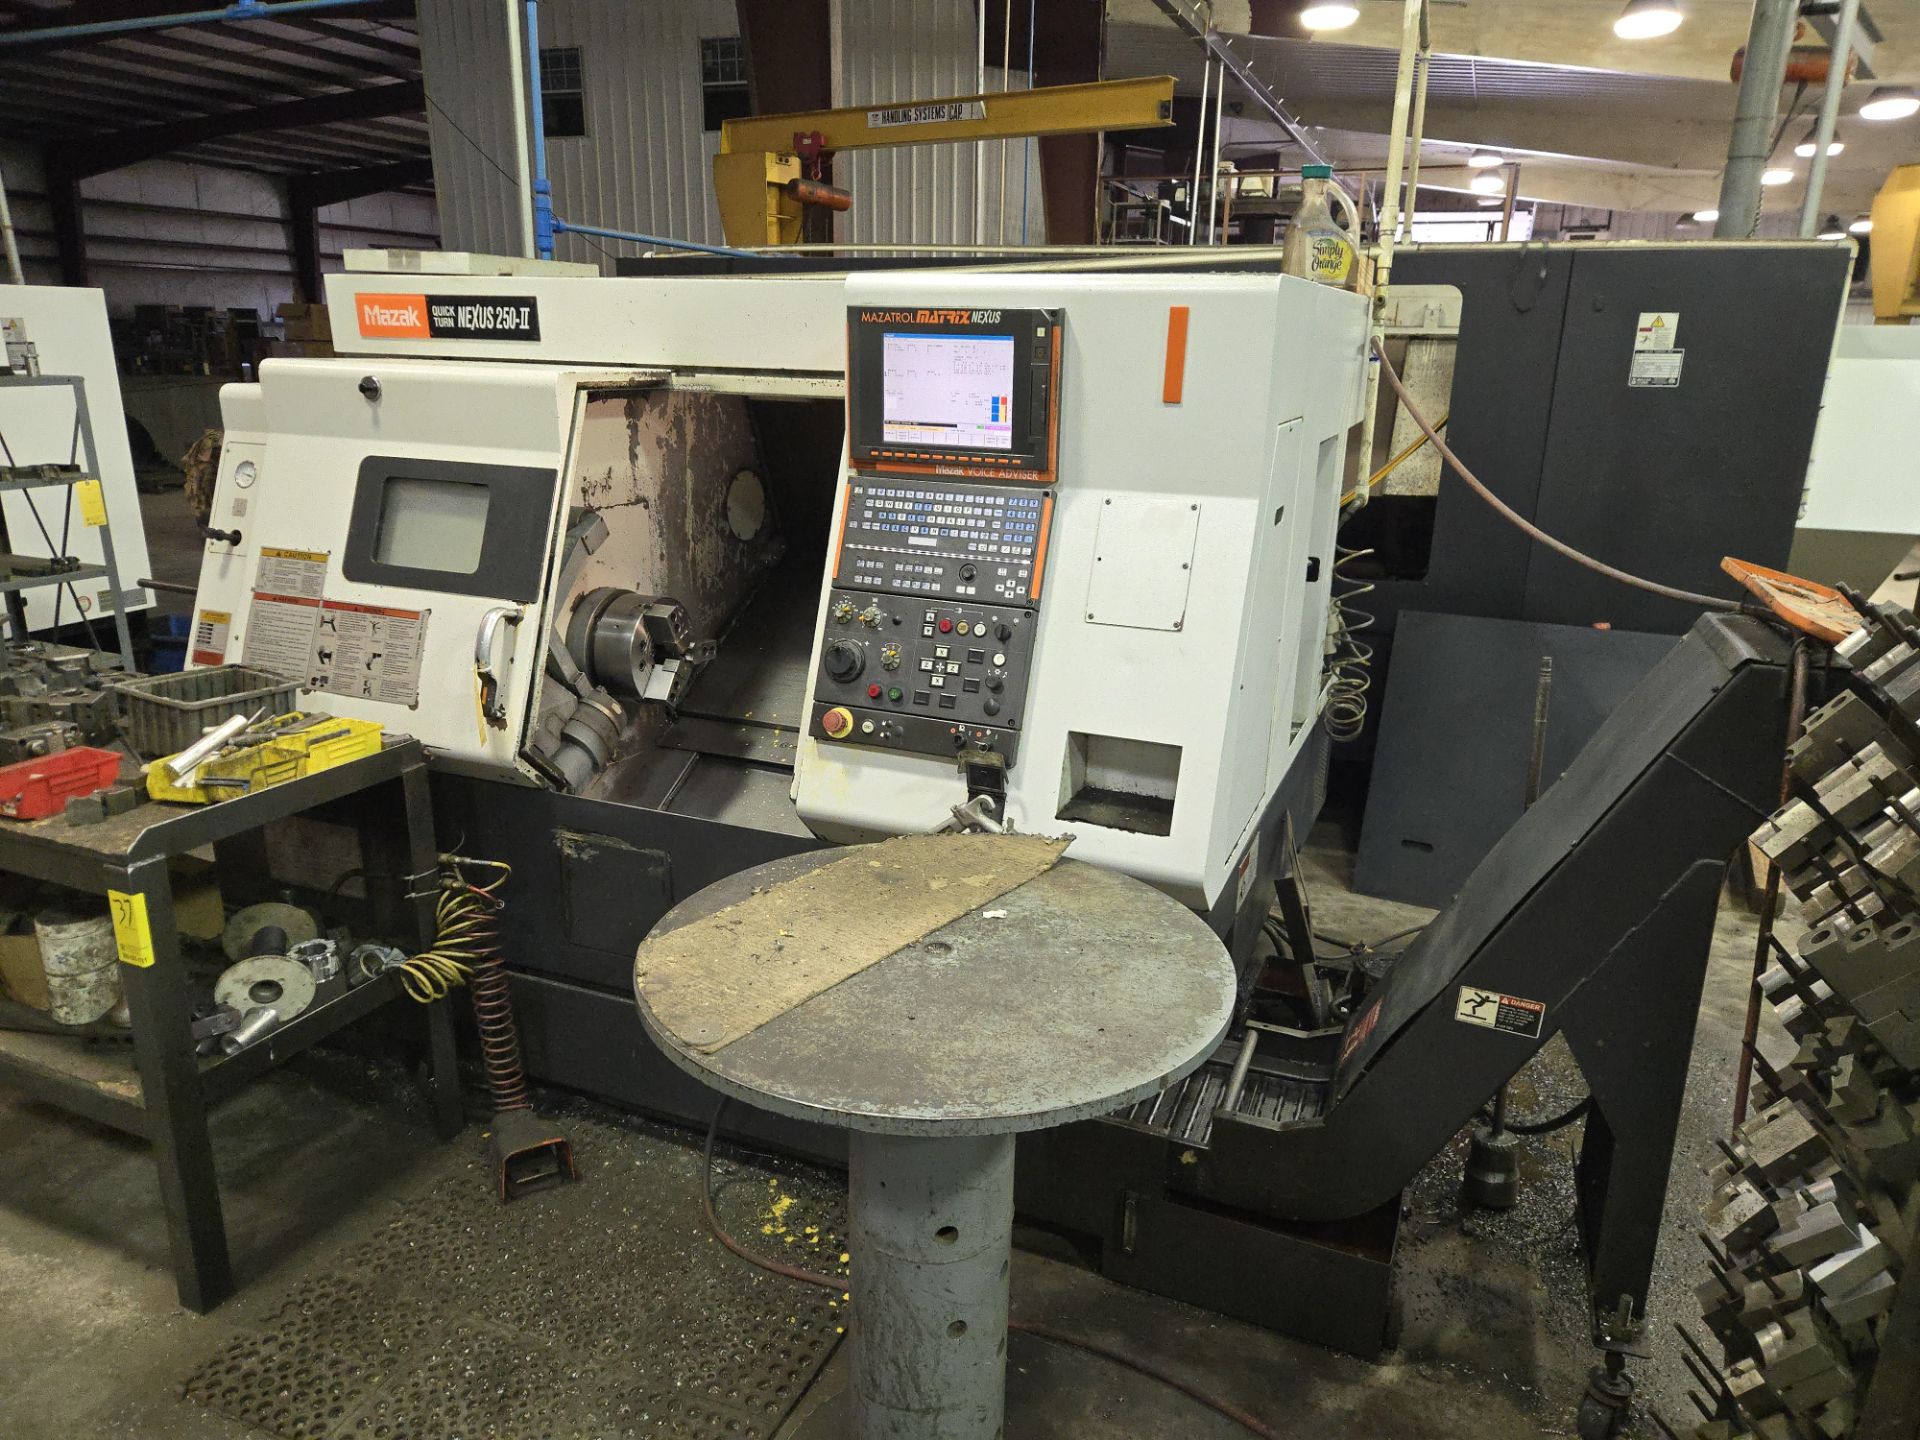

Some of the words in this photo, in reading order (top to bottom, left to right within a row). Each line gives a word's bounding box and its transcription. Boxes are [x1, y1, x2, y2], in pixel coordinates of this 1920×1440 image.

[881, 110, 912, 124] HANDLING
[914, 105, 946, 121] SYSTEMS
[1312, 240, 1344, 259] Simply
[1311, 257, 1342, 274] Orange
[363, 304, 421, 327] Mazak
[432, 305, 456, 317] QUICK
[457, 304, 494, 331] NEXUS
[861, 311, 915, 324] MAZATROL
[971, 310, 1001, 324] NEXUS
[434, 317, 455, 328] TURN
[935, 465, 964, 476] Mazak
[967, 468, 995, 477] VOICE
[998, 469, 1039, 481] ADVISER
[283, 551, 312, 560] CAUTION
[112, 899, 132, 926] 37
[1510, 999, 1541, 1010] DANGER
